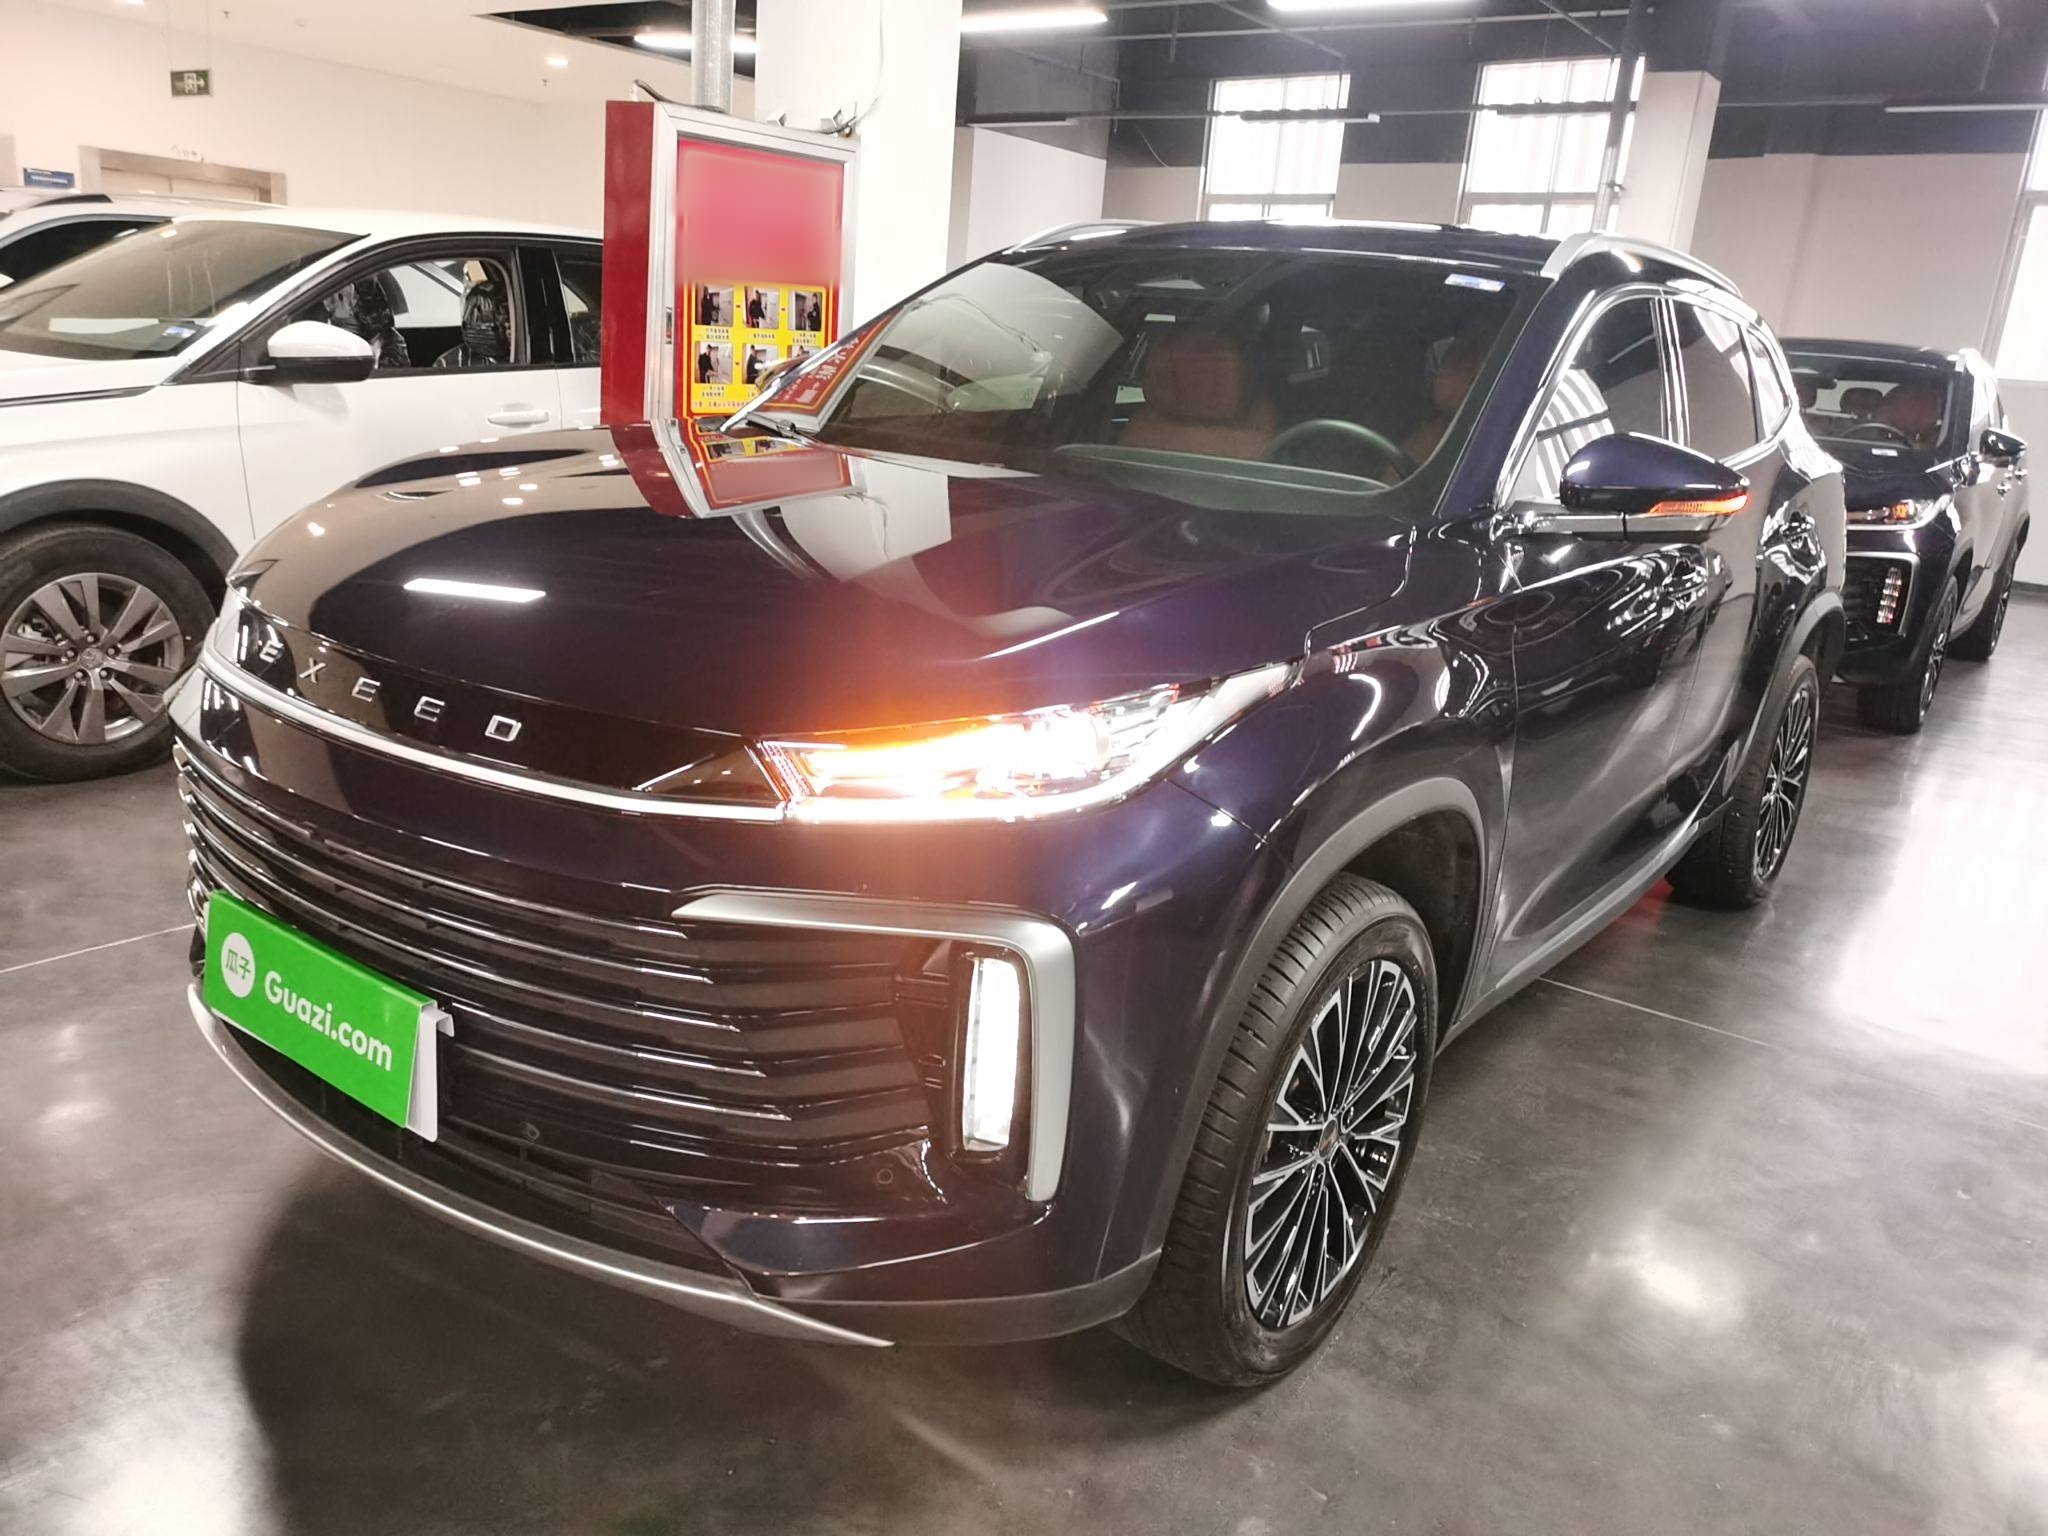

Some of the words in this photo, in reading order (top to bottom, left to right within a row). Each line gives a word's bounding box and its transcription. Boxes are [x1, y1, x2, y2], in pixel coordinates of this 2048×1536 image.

[258, 640, 522, 742] EXEED
[226, 948, 251, 980] 瓜子
[264, 970, 393, 1072] Guazi.com
